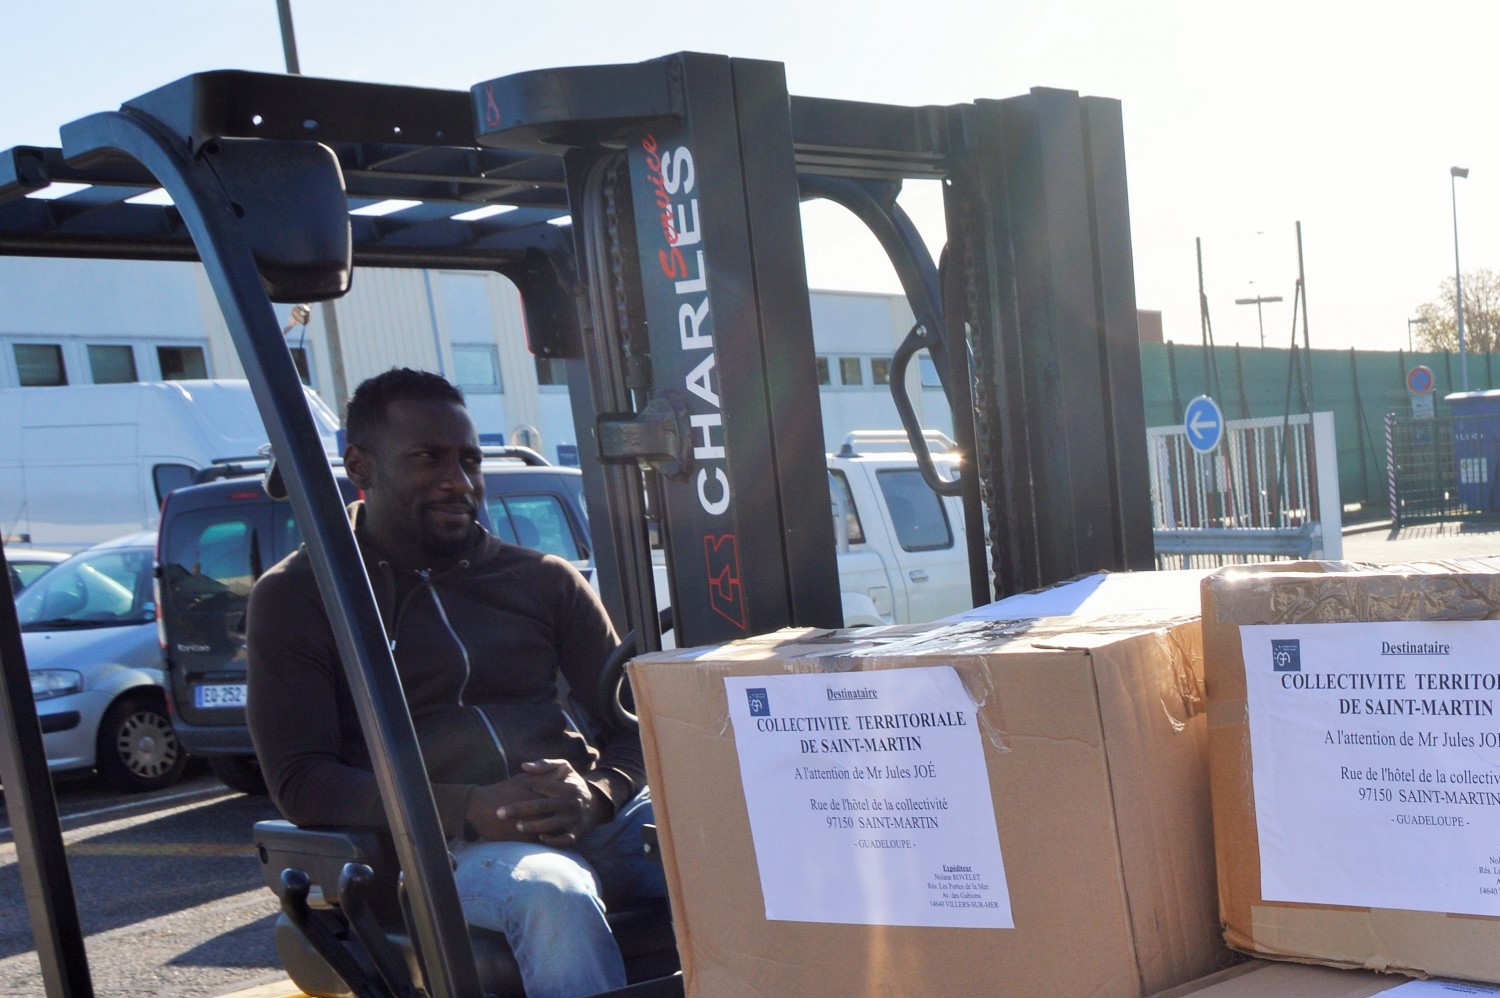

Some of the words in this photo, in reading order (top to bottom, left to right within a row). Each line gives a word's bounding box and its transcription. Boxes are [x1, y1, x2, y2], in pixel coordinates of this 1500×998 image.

[643, 134, 686, 278] Service
[663, 145, 731, 515] CHARLES
[1381, 642, 1450, 656] Destinataire
[1281, 674, 1405, 690] COLLECTIVITE
[827, 688, 878, 700] Destinataire
[1340, 700, 1361, 715] DE
[1366, 699, 1493, 716] SAINT-MARTIN
[757, 716, 849, 732] COLLECTIVITE
[856, 712, 966, 729] TERRITORIALE
[801, 740, 817, 753] DE
[822, 737, 922, 753] SAINT-MARTIN
[1325, 731, 1333, 745] A
[1338, 731, 1396, 746] l'attention
[1399, 732, 1414, 746] de
[1418, 732, 1438, 747] Mr
[1443, 732, 1475, 747] Jules
[795, 768, 802, 780] A
[805, 767, 850, 780] l'attention
[853, 767, 864, 779] de
[867, 766, 882, 779] Mr
[886, 766, 911, 779] Jules
[915, 762, 936, 778] JOÉ
[1341, 767, 1362, 781] Rue
[1366, 767, 1378, 782] de
[1382, 768, 1414, 782] l'hôtel
[1419, 769, 1432, 783] de
[1436, 769, 1446, 783] la
[810, 799, 827, 810] Rue
[830, 799, 839, 810] de
[842, 799, 868, 810] l'hôtel
[871, 799, 881, 810] de
[885, 799, 892, 810] la
[896, 798, 948, 810] collectivité
[1359, 788, 1392, 803] 97150
[1399, 789, 1500, 805] SAINT-MARTIN
[827, 817, 853, 829] 97150
[858, 817, 939, 829] SAINT-MARTIN
[1397, 815, 1464, 827] GUADELOUPE
